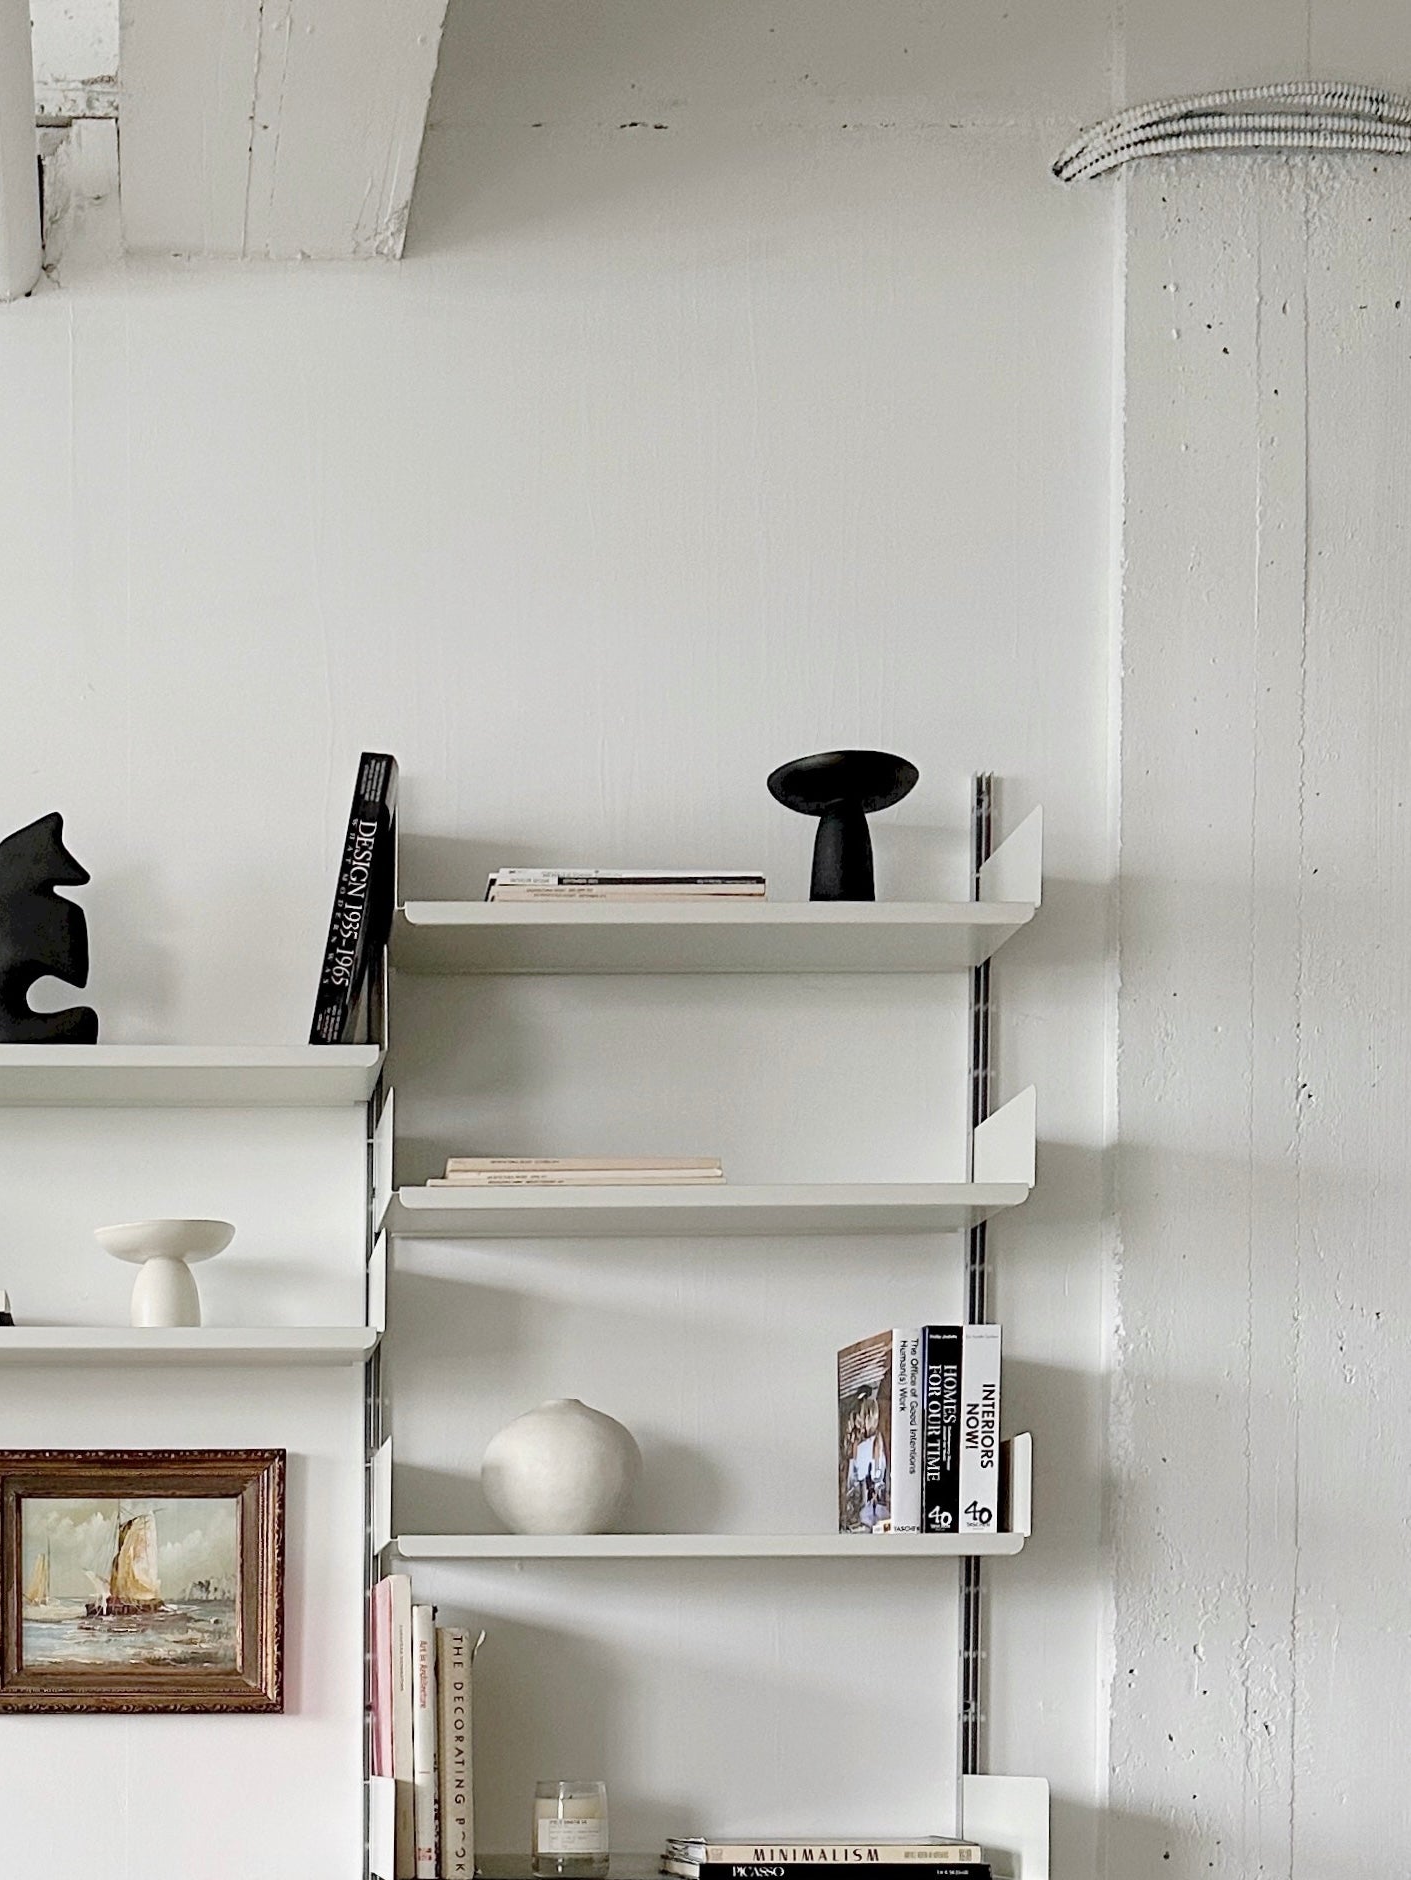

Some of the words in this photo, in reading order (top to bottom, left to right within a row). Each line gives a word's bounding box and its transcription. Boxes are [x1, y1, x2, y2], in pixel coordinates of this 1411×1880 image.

[347, 820, 378, 899] DESIGN
[331, 903, 363, 987] 1935-1965
[910, 1338, 919, 1356] The
[910, 1358, 919, 1387] Office
[928, 1365, 942, 1397] FOR
[898, 1387, 908, 1412] Work
[909, 1388, 919, 1398] of
[942, 1365, 958, 1424] HOMES
[909, 1400, 919, 1426] Good
[927, 1400, 942, 1437] OUR
[980, 1383, 996, 1469] INTERIORS
[908, 1428, 918, 1475] Intentions
[926, 1439, 941, 1481] TIME
[928, 1505, 953, 1525] 40
[964, 1500, 993, 1525] 40
[453, 1635, 464, 1669] THE
[453, 1682, 466, 1805] DECORATING
[752, 1848, 880, 1862] MINIMALISM
[732, 1866, 785, 1878] PICASSO
